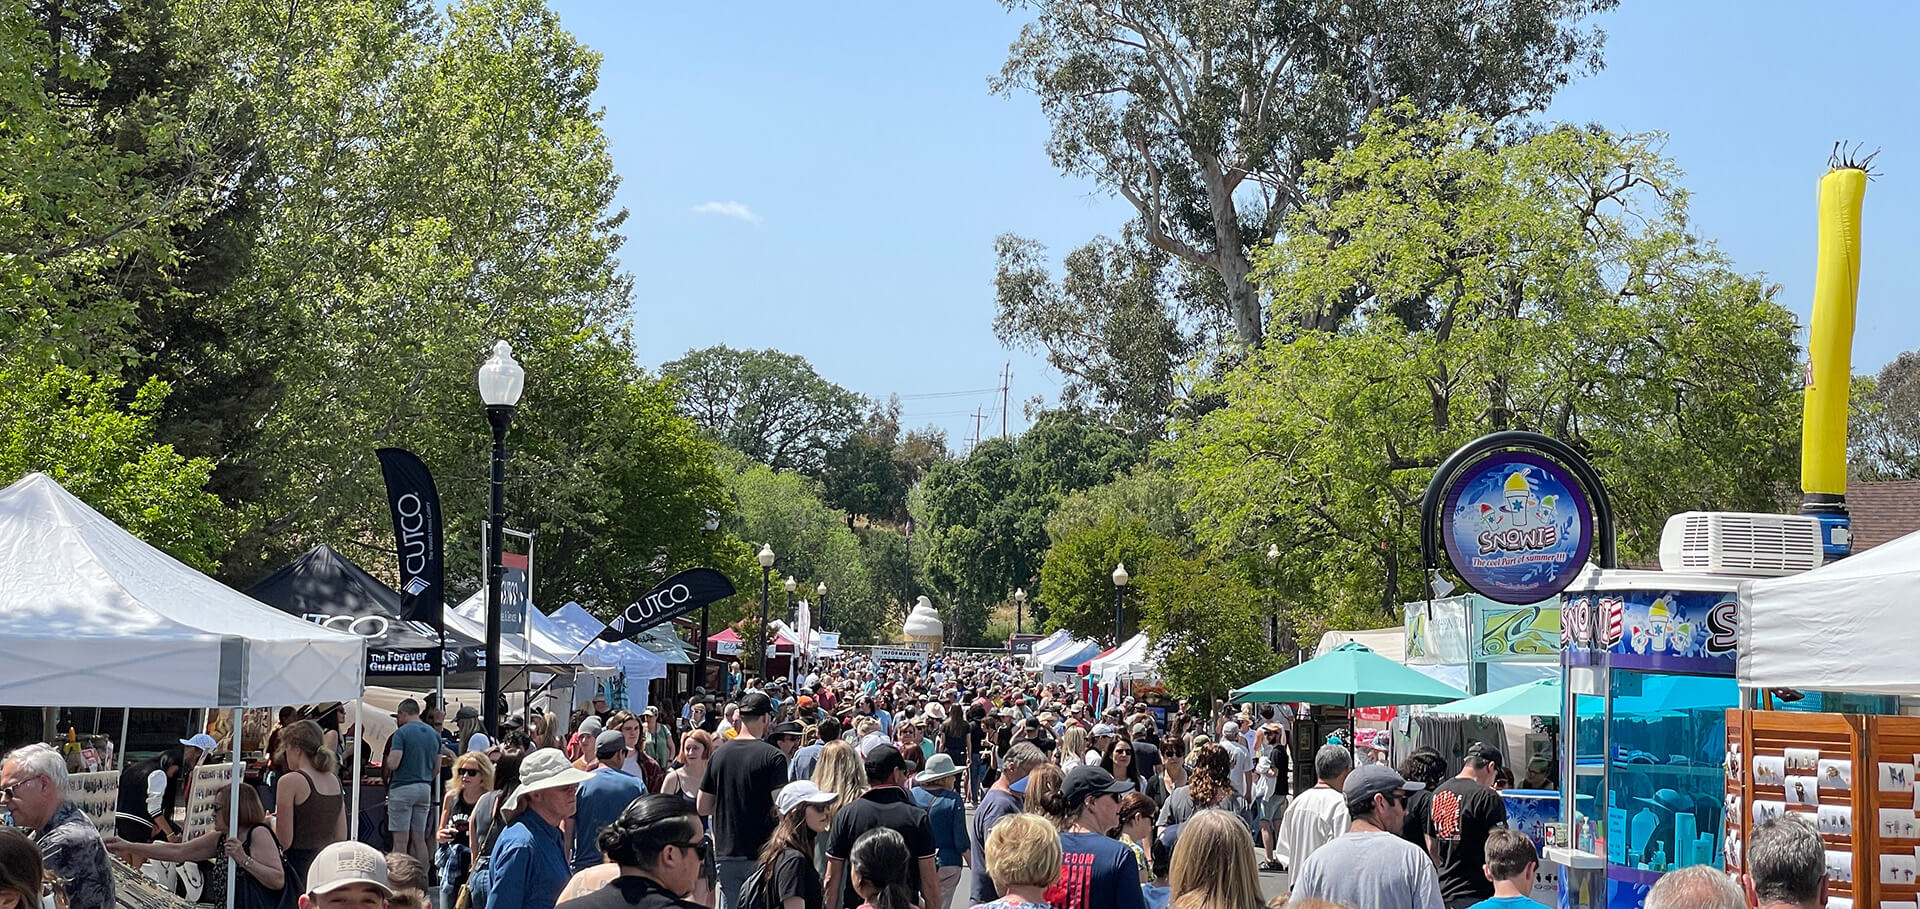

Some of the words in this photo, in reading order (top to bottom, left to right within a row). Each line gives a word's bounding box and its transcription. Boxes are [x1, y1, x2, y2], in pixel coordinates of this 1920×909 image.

[398, 494, 426, 575] CUTCO
[1479, 526, 1557, 554] SNOWIE
[1474, 558, 1485, 566] The
[625, 584, 690, 623] CUTCO
[1560, 597, 1624, 648] SNOWIE
[369, 662, 431, 672] Guarantee
[371, 654, 386, 663] The
[387, 651, 427, 662] Forever
